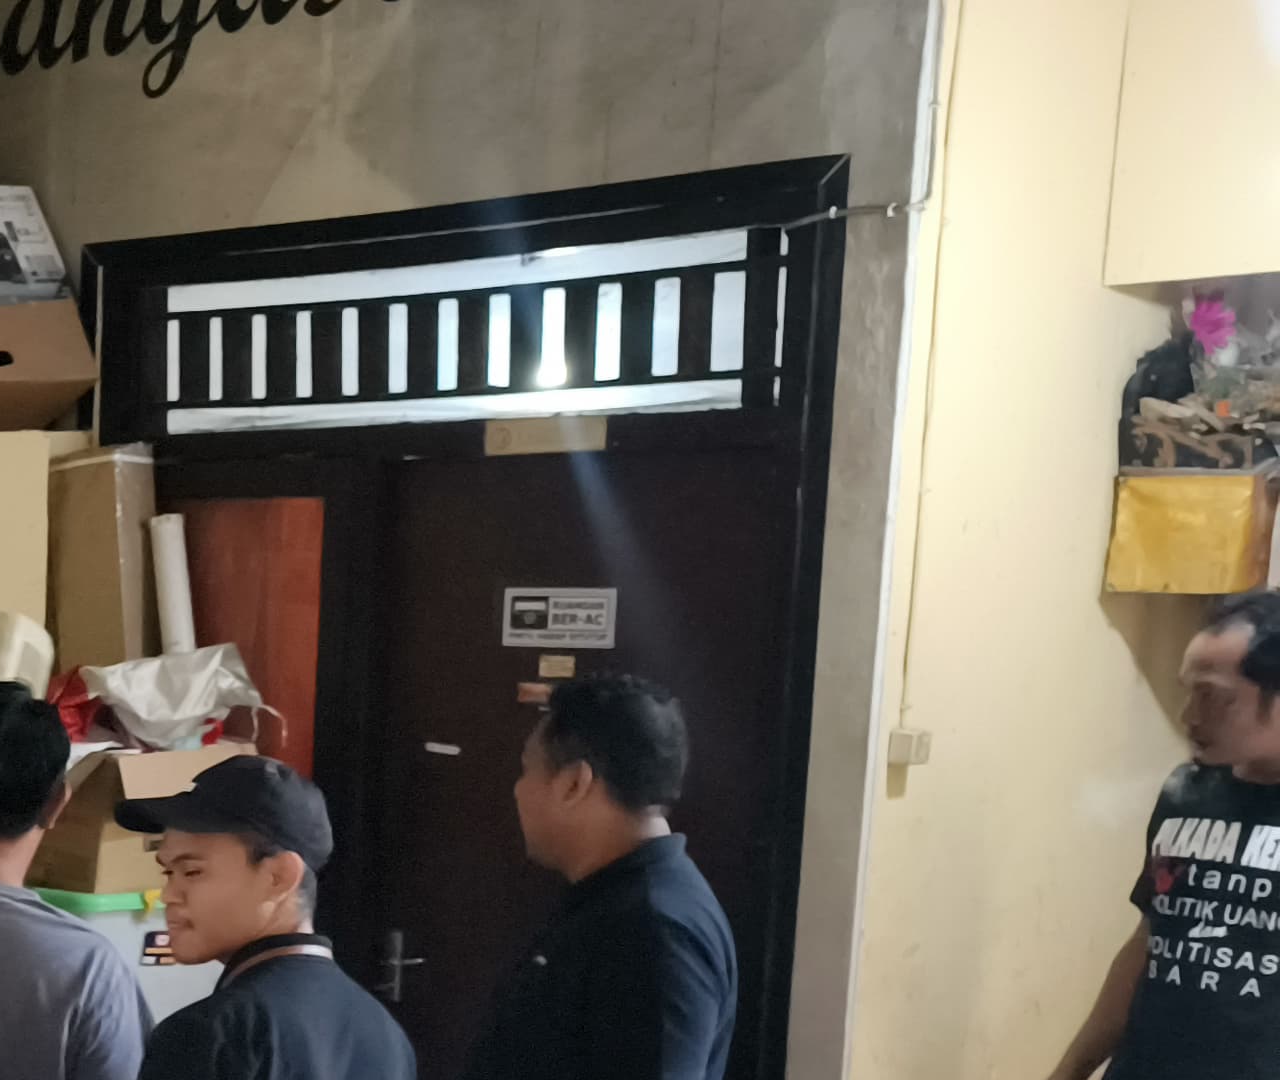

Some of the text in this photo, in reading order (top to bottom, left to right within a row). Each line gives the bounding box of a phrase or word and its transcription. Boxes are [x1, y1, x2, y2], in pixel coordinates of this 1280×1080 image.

[1188, 864, 1274, 902] tanp
[1151, 893, 1280, 932] OLITIK UAN
[1147, 935, 1280, 976] OLITISAS
